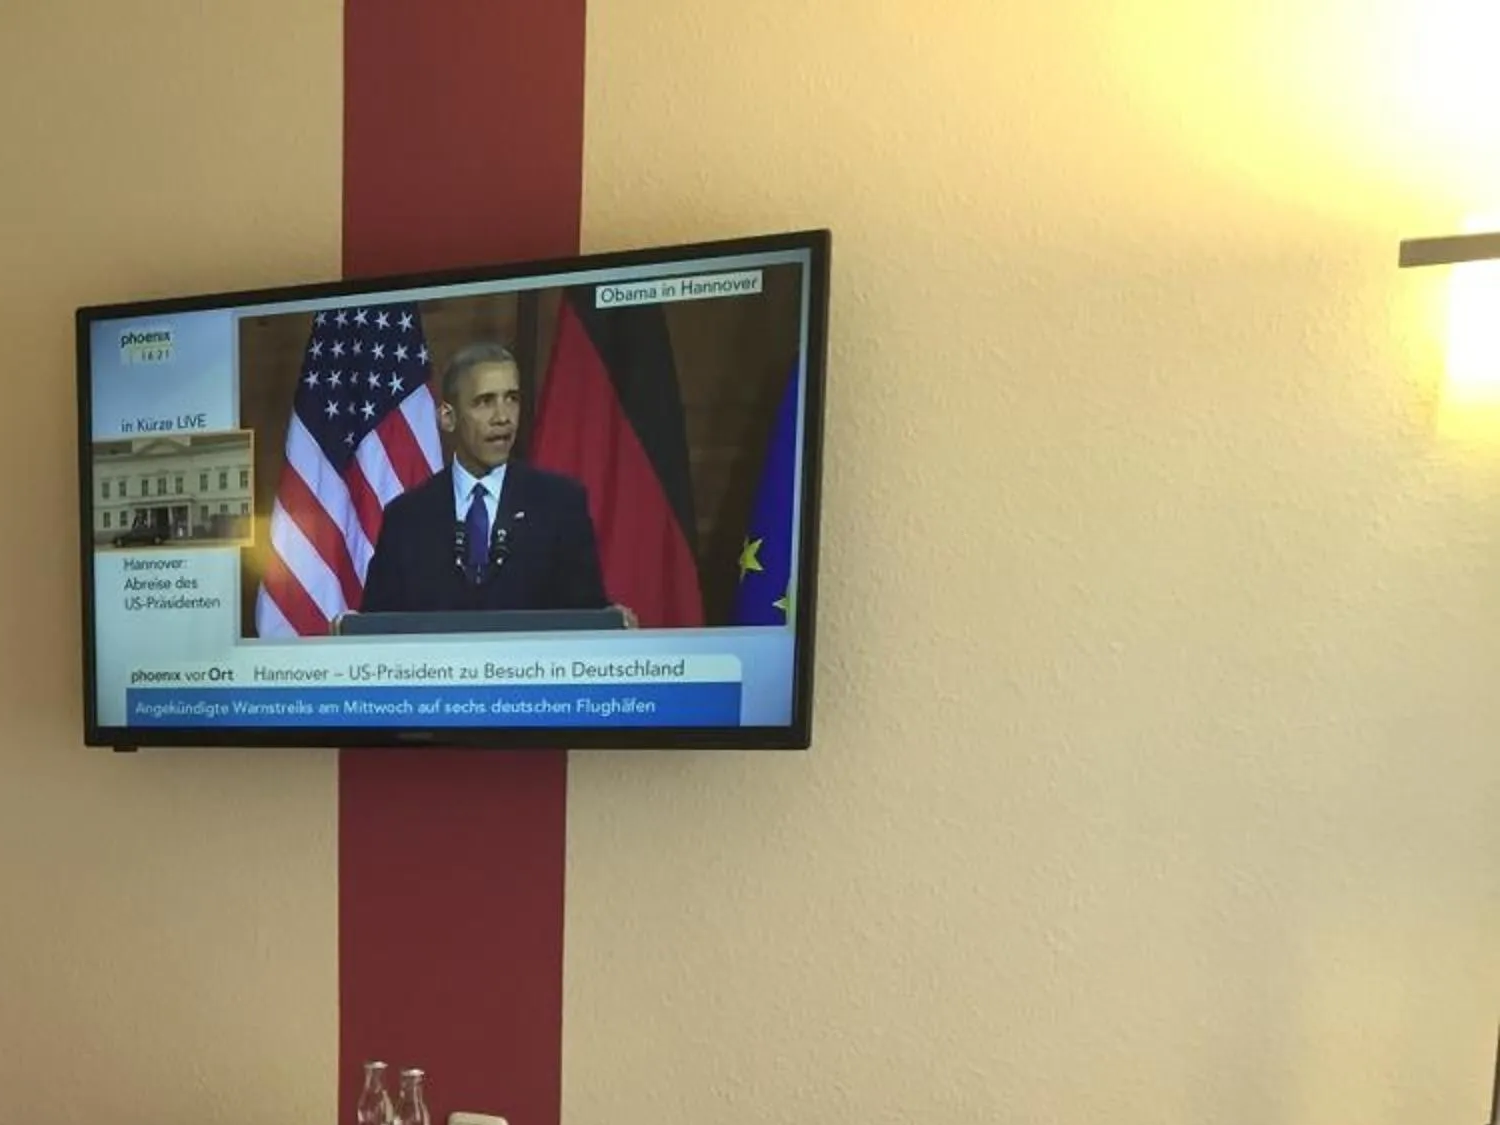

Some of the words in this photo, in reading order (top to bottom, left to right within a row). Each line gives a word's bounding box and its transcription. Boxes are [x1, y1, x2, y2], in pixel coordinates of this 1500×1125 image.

[601, 284, 657, 304] Obama
[662, 283, 676, 297] in
[681, 277, 758, 296] Hannover
[121, 332, 171, 348] phoenix
[121, 419, 133, 432] in
[137, 417, 173, 432] Kürze
[177, 414, 207, 429] LIVE
[124, 577, 172, 591] Abreise
[175, 576, 198, 589] des
[124, 594, 221, 611] US-Präsidenten
[131, 670, 181, 683] phoenix
[184, 672, 206, 682] vor
[208, 668, 235, 681] Ort
[253, 667, 330, 681] Hannover
[349, 664, 454, 680] US-Präsident
[459, 668, 478, 678] zu
[484, 662, 545, 679] Besuch
[551, 661, 566, 678] in
[572, 659, 685, 678] Deutschland
[135, 699, 229, 719] Angekündigte
[232, 699, 313, 715] Warnstreiks
[318, 702, 340, 715] am
[343, 699, 414, 716] Mittwoch
[417, 697, 440, 714] auf
[445, 698, 486, 714] sechs
[491, 697, 571, 714] deutschen
[576, 697, 657, 717] Flughäfen
